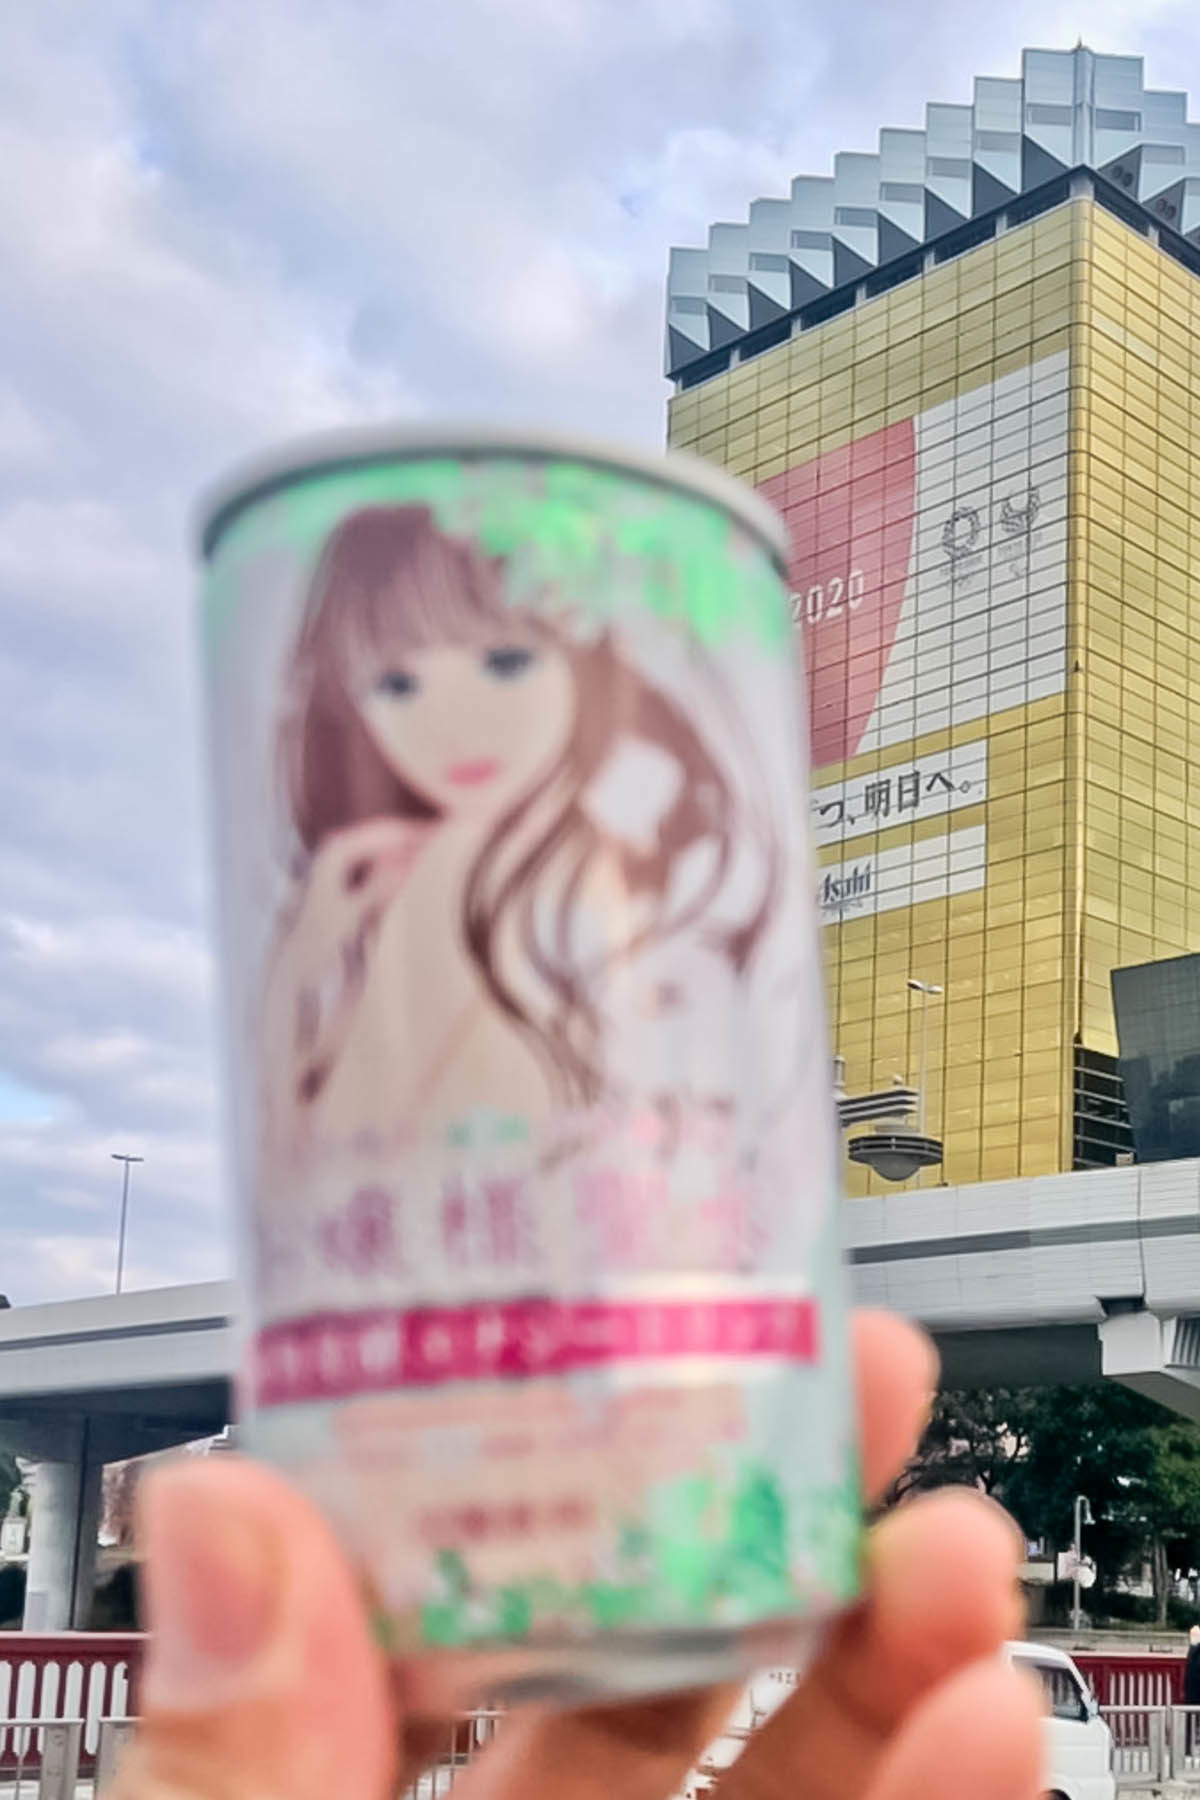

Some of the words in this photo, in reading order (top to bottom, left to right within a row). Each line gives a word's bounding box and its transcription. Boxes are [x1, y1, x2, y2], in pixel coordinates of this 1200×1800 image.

[790, 568, 864, 629] 2020
[812, 770, 971, 829] つ、明日へ。
